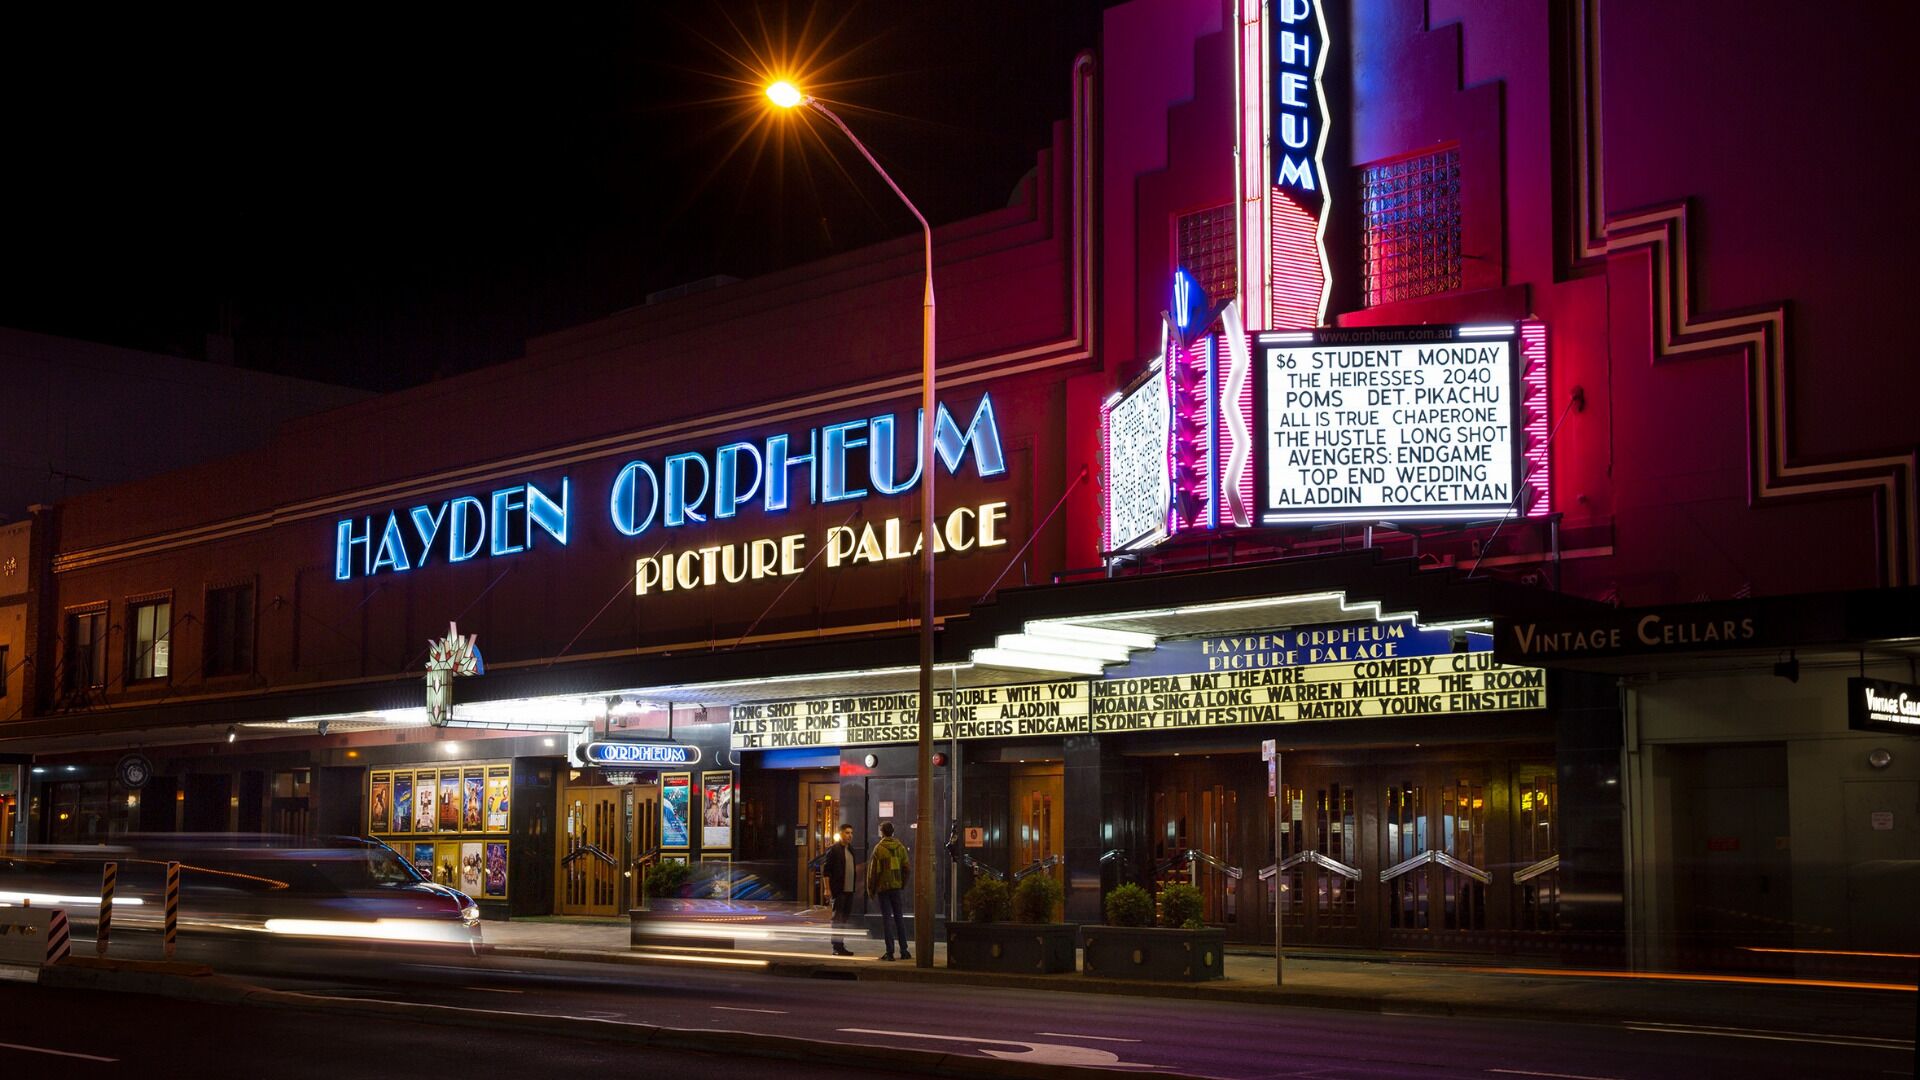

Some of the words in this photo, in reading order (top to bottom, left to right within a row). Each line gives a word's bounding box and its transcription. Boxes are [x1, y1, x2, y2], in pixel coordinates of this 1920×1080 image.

[1319, 329, 1453, 343] www.orpheum.com.au
[1276, 353, 1297, 369] $6
[1311, 350, 1402, 369] STUDENT
[1418, 347, 1500, 366] MONDAY
[1287, 374, 1321, 388] THE
[1330, 370, 1424, 386] HEIRESSES
[1443, 368, 1491, 384] 2040
[1286, 391, 1343, 408] POMS
[1367, 389, 1410, 406] DET.
[1415, 386, 1499, 404] PIKACHU
[1279, 412, 1310, 427] ALL
[1315, 412, 1330, 426] IS
[1335, 411, 1379, 425] TRUE
[1392, 408, 1497, 425] CHAPERONE
[1274, 431, 1310, 447] THE
[1315, 429, 1386, 446] HUSTLE
[1400, 428, 1451, 443] LONG
[1457, 426, 1508, 442] SHOT
[1288, 448, 1392, 466] AVENGERS:
[1397, 445, 1492, 463] ENDGAME
[335, 477, 568, 581] HAYDEN
[610, 391, 1007, 537] ORPHEUM
[1298, 469, 1338, 485] TOP
[1348, 468, 1385, 484] END
[1396, 465, 1487, 482] WEDDING
[1278, 487, 1361, 505] ALADDIN
[1382, 484, 1508, 502] ROCKETMAN
[635, 534, 805, 596] PICTURE
[826, 502, 1008, 568] PALACE
[1202, 634, 1285, 654] HAYDEN
[1297, 624, 1405, 646] ORPHEUM
[1514, 624, 1621, 655] VINTAGE
[1637, 615, 1754, 646] CELLARS
[1209, 650, 1298, 670] PICTURE
[1310, 642, 1398, 663] PALACE
[1190, 673, 1221, 690] NAT
[1228, 667, 1305, 687] THEATRE
[1354, 656, 1435, 679] COMEDY
[733, 705, 762, 720] LONG
[767, 702, 797, 717] SHOT
[806, 701, 829, 715] TOP
[832, 699, 855, 714] END
[859, 695, 917, 711] WEDDING
[937, 689, 998, 707] TROUBLE
[1006, 685, 1040, 702] WITH
[1047, 683, 1077, 700] YOU
[1092, 697, 1149, 714] MOANA
[1153, 692, 1189, 709] SING
[1267, 682, 1342, 703] WARREN
[1353, 677, 1420, 697] MILLER
[1438, 674, 1473, 693] THE
[1484, 669, 1542, 690] ROOM
[733, 719, 754, 734] ALL
[756, 719, 767, 733] IS
[771, 717, 798, 732] TRUE
[806, 715, 840, 730] POMS
[848, 711, 893, 728] HUSTLE
[1000, 701, 1060, 719] ALADDIN
[1096, 711, 1155, 730] SYDNEY
[1163, 709, 1200, 726] FILM
[1206, 704, 1285, 724] FESTIVAL
[1297, 699, 1363, 719] MATRIX
[1378, 694, 1442, 714] YOUNG
[1450, 689, 1539, 711] EINSTEIN
[743, 734, 765, 748] DET
[771, 731, 821, 747] PIKACHU
[847, 725, 918, 743] HEIRESSES
[1018, 716, 1088, 734] ENDGAME
[605, 745, 685, 761] ORPHEUM
